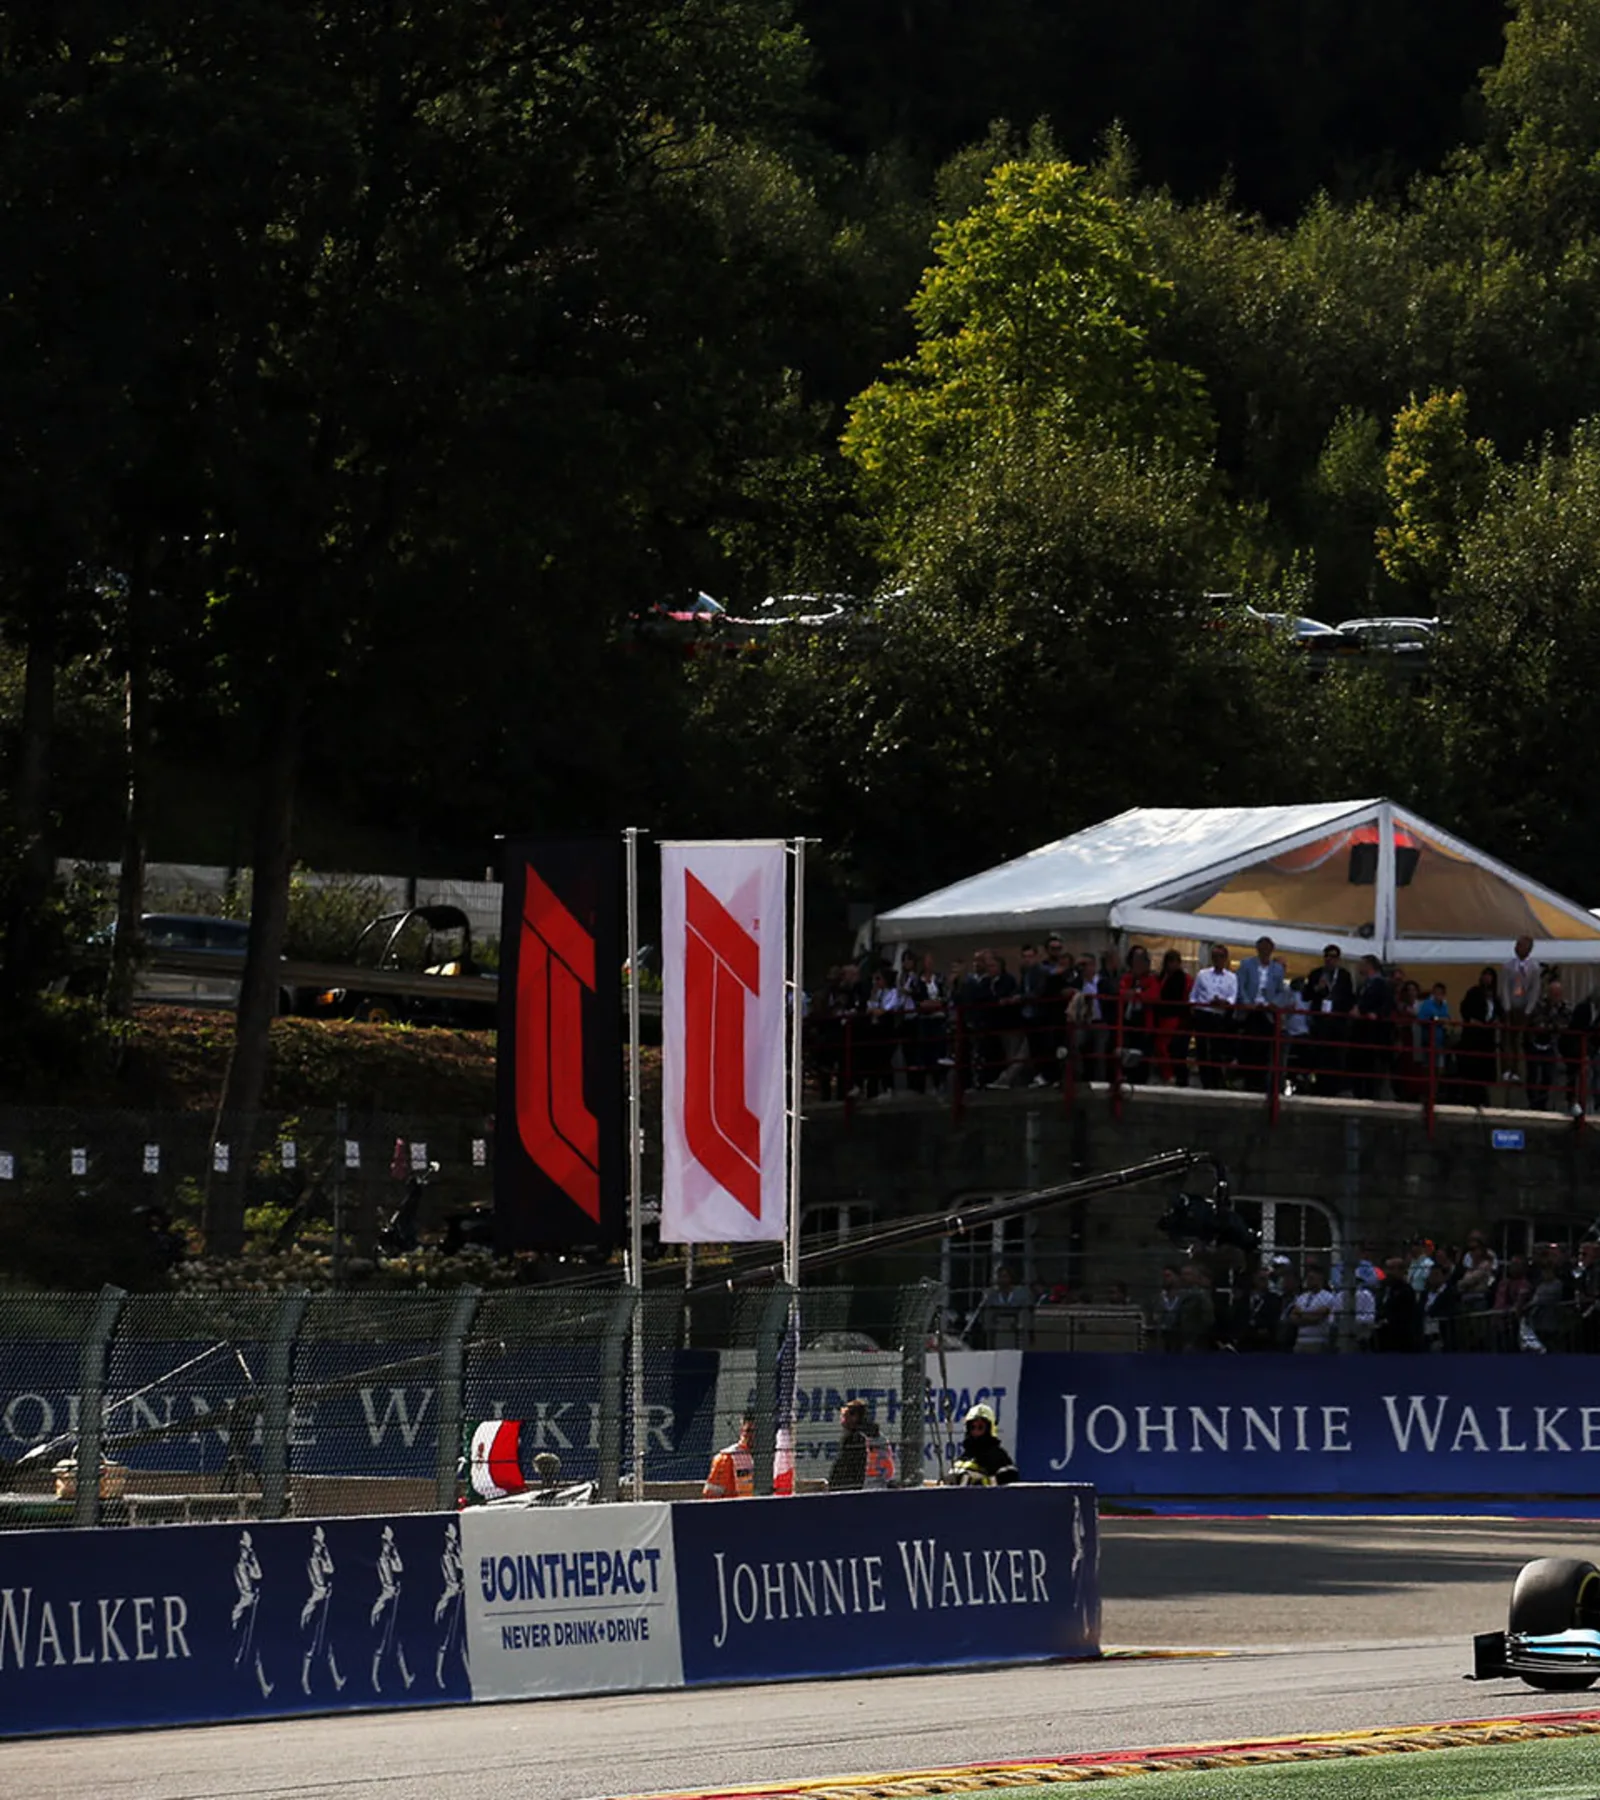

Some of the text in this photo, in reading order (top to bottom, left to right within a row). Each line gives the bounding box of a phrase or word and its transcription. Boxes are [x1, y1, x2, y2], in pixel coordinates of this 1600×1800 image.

[359, 1387, 676, 1451] WKR
[1049, 1394, 1354, 1471] JOHNNIE
[479, 1548, 662, 1603] #JOINTHEPACT
[712, 1533, 1051, 1649] JOHNNIE WALKER
[501, 1623, 552, 1650] NEVER
